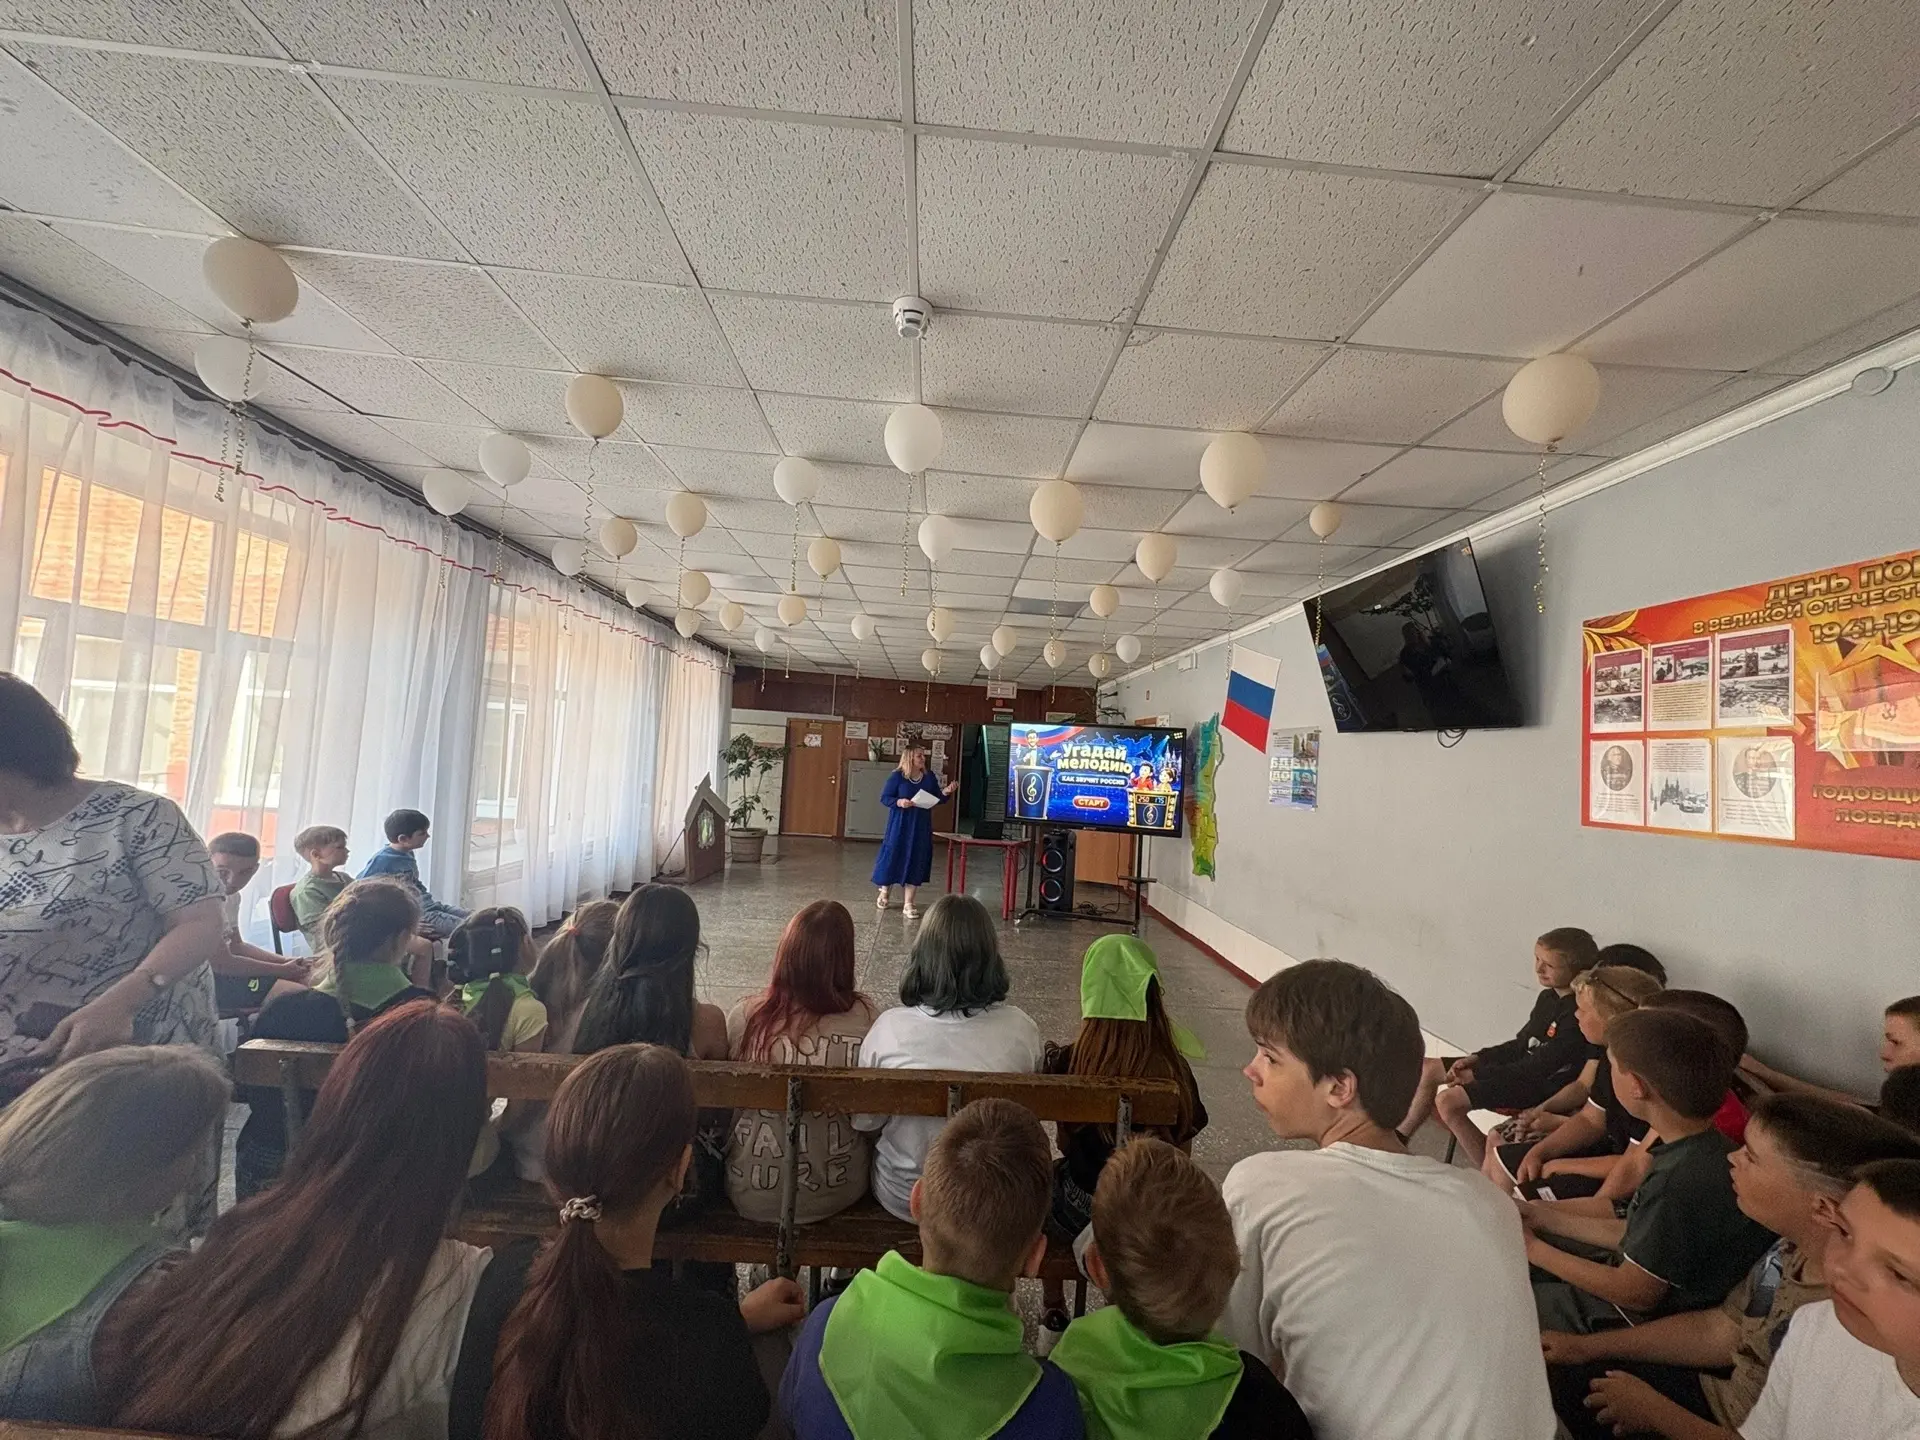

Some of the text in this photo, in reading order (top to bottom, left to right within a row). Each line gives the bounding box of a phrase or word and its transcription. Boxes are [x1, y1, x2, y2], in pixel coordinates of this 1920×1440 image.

[1766, 572, 1852, 608] ДЕНЬ
[1693, 621, 1705, 634] В
[1709, 601, 1802, 631] ВЕЛИКОЙ
[1809, 609, 1920, 644] 1941-19
[1062, 743, 1127, 760] Угадай
[1057, 758, 1133, 774] мелодию
[1075, 776, 1099, 784] ЗВУЧИТ
[1078, 798, 1105, 807] СТАРТ
[768, 1033, 864, 1067] ON'T
